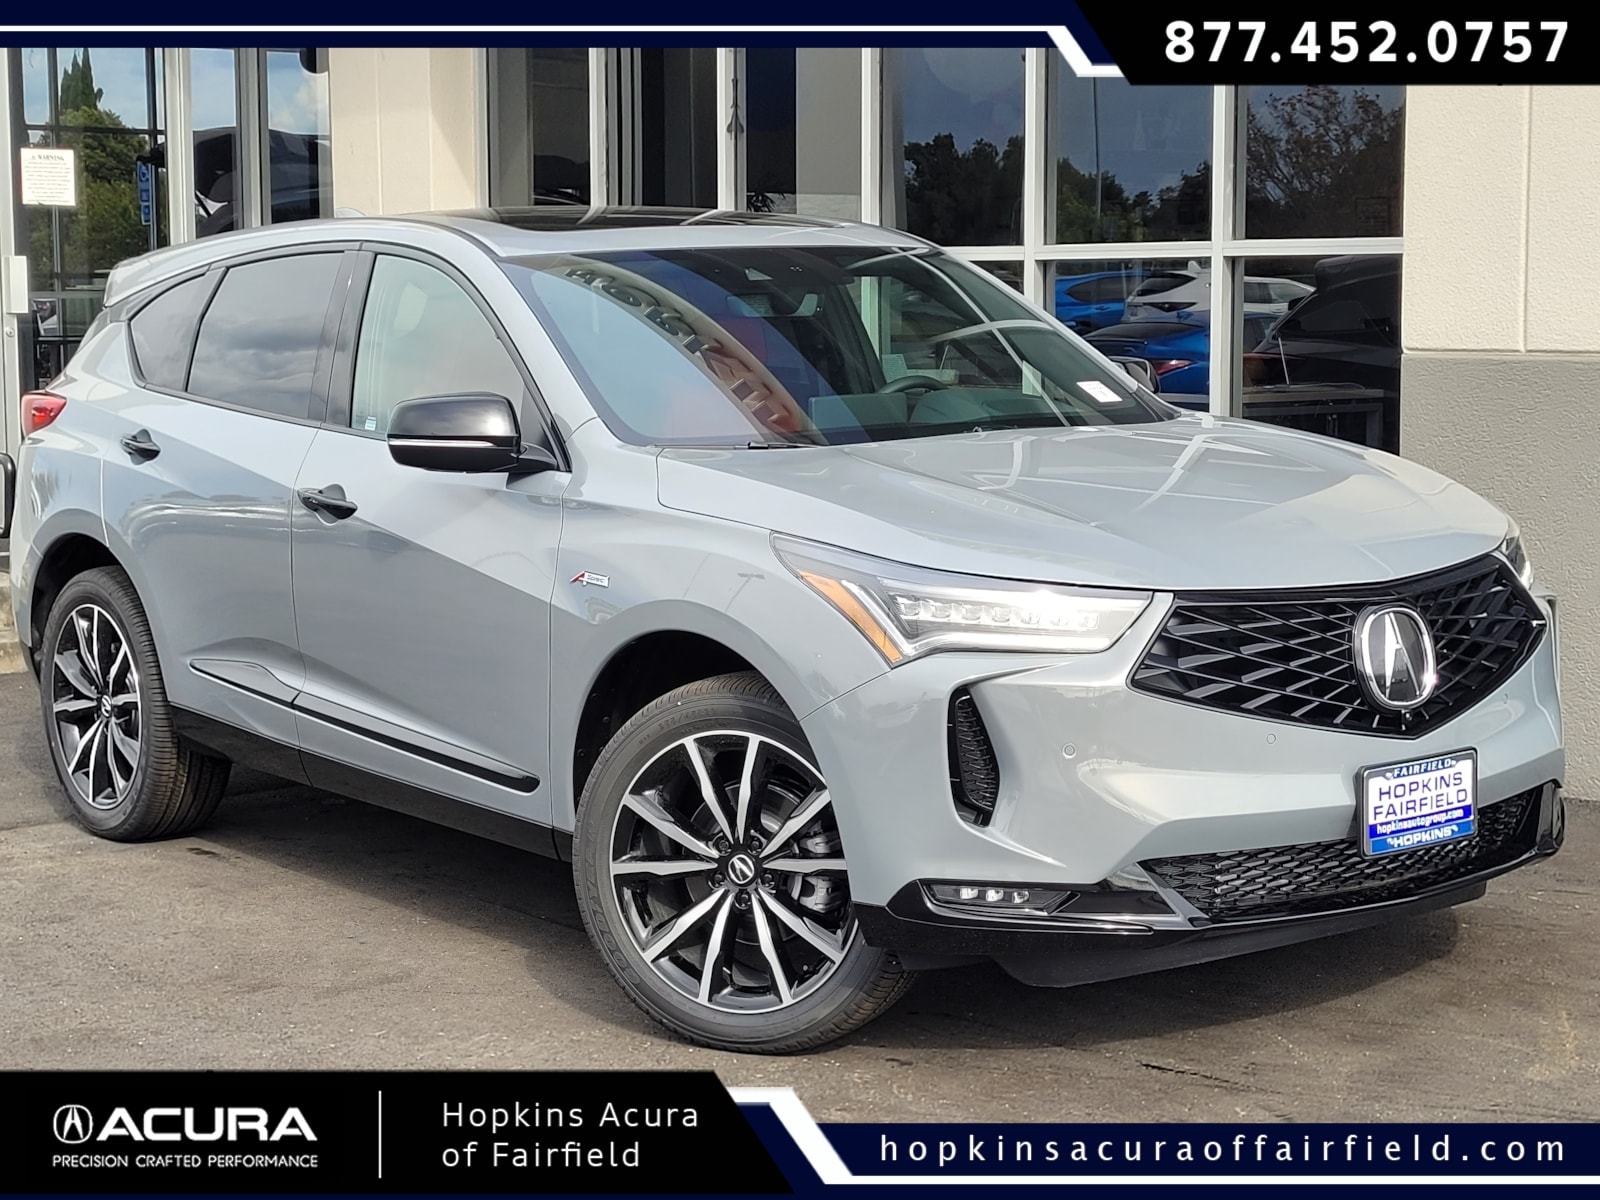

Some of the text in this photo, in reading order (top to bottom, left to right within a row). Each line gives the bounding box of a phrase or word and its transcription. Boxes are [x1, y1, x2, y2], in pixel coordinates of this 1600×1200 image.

[1393, 758, 1453, 778] FAIRFIELD
[1379, 771, 1463, 801] HOPKINS
[1373, 788, 1468, 821] FAIRFIELD
[1376, 808, 1464, 835] hopkinsautogroup.com
[1394, 827, 1452, 848] HOPKINS
